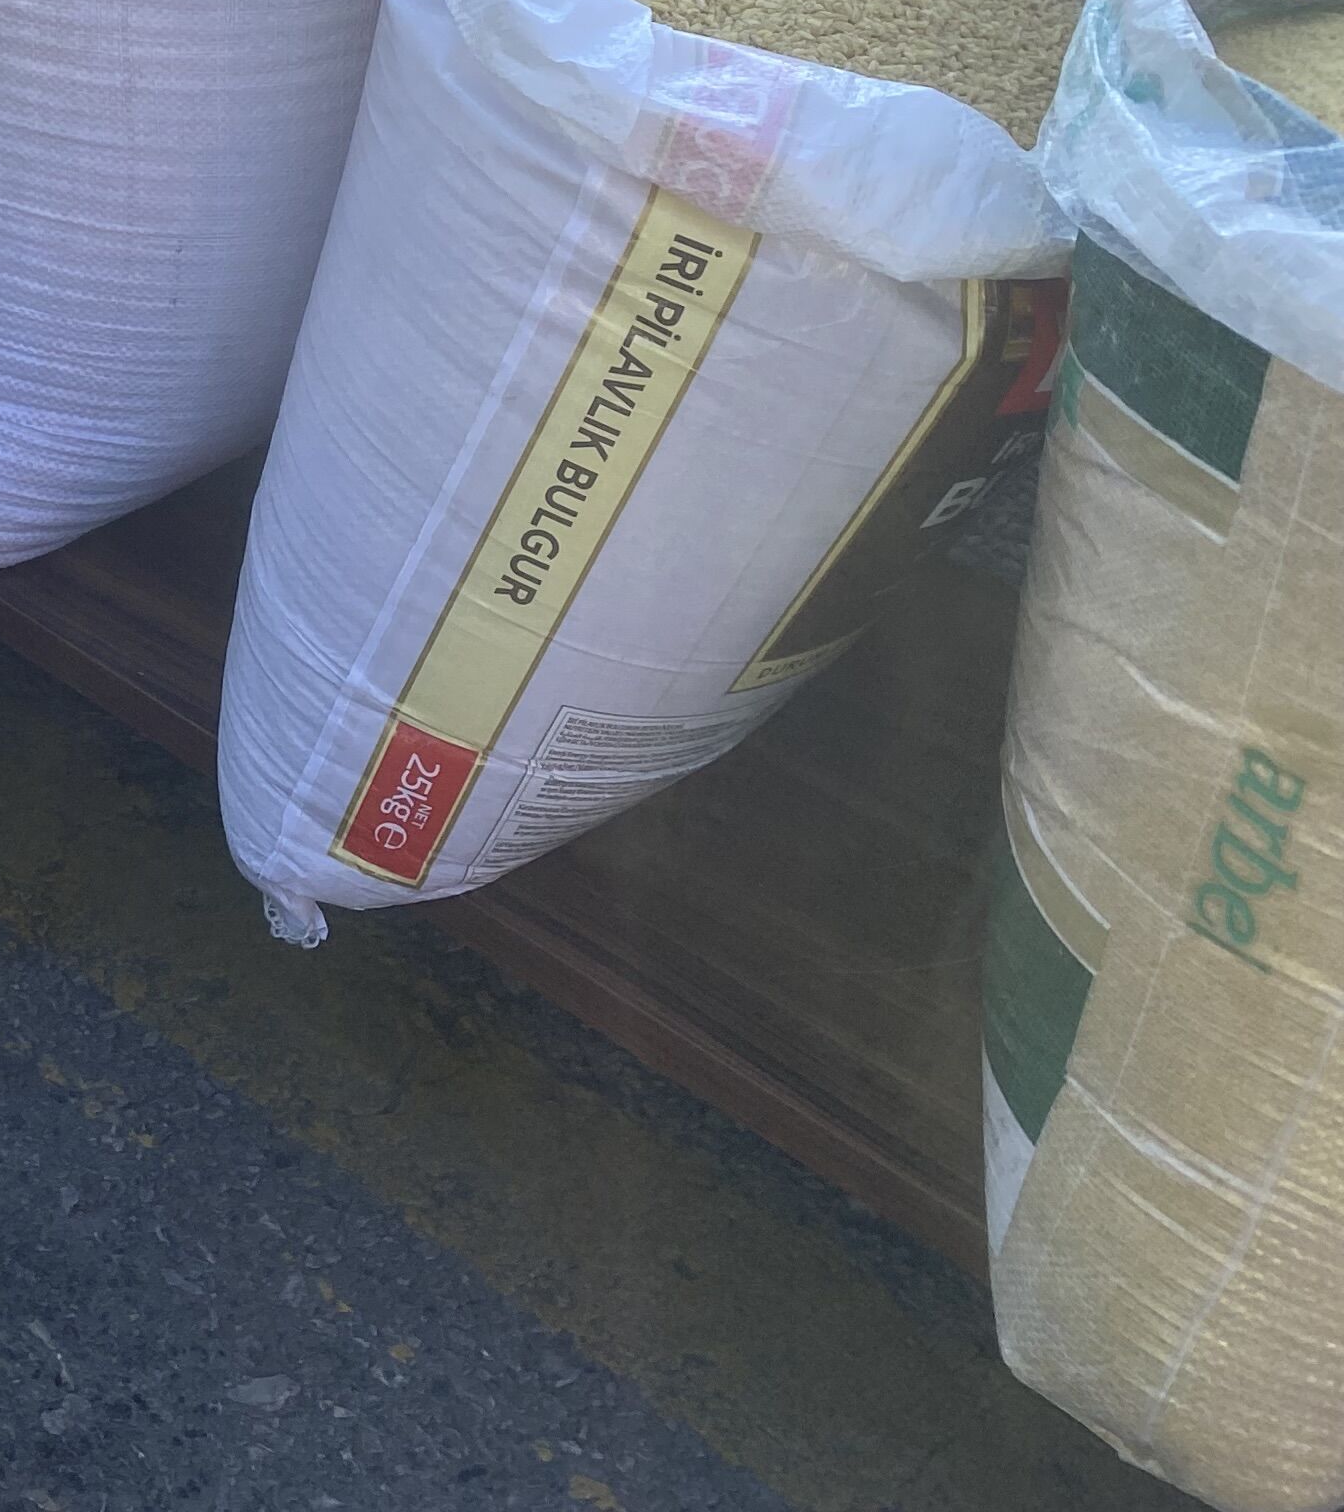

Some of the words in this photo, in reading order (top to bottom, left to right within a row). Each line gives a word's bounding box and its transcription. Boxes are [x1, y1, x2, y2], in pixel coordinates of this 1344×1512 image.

[655, 234, 724, 297] İRİ
[569, 292, 686, 463] PİLAVLIK
[493, 458, 600, 607] BULGUR
[379, 752, 441, 823] 25kg
[411, 803, 433, 830] NET
